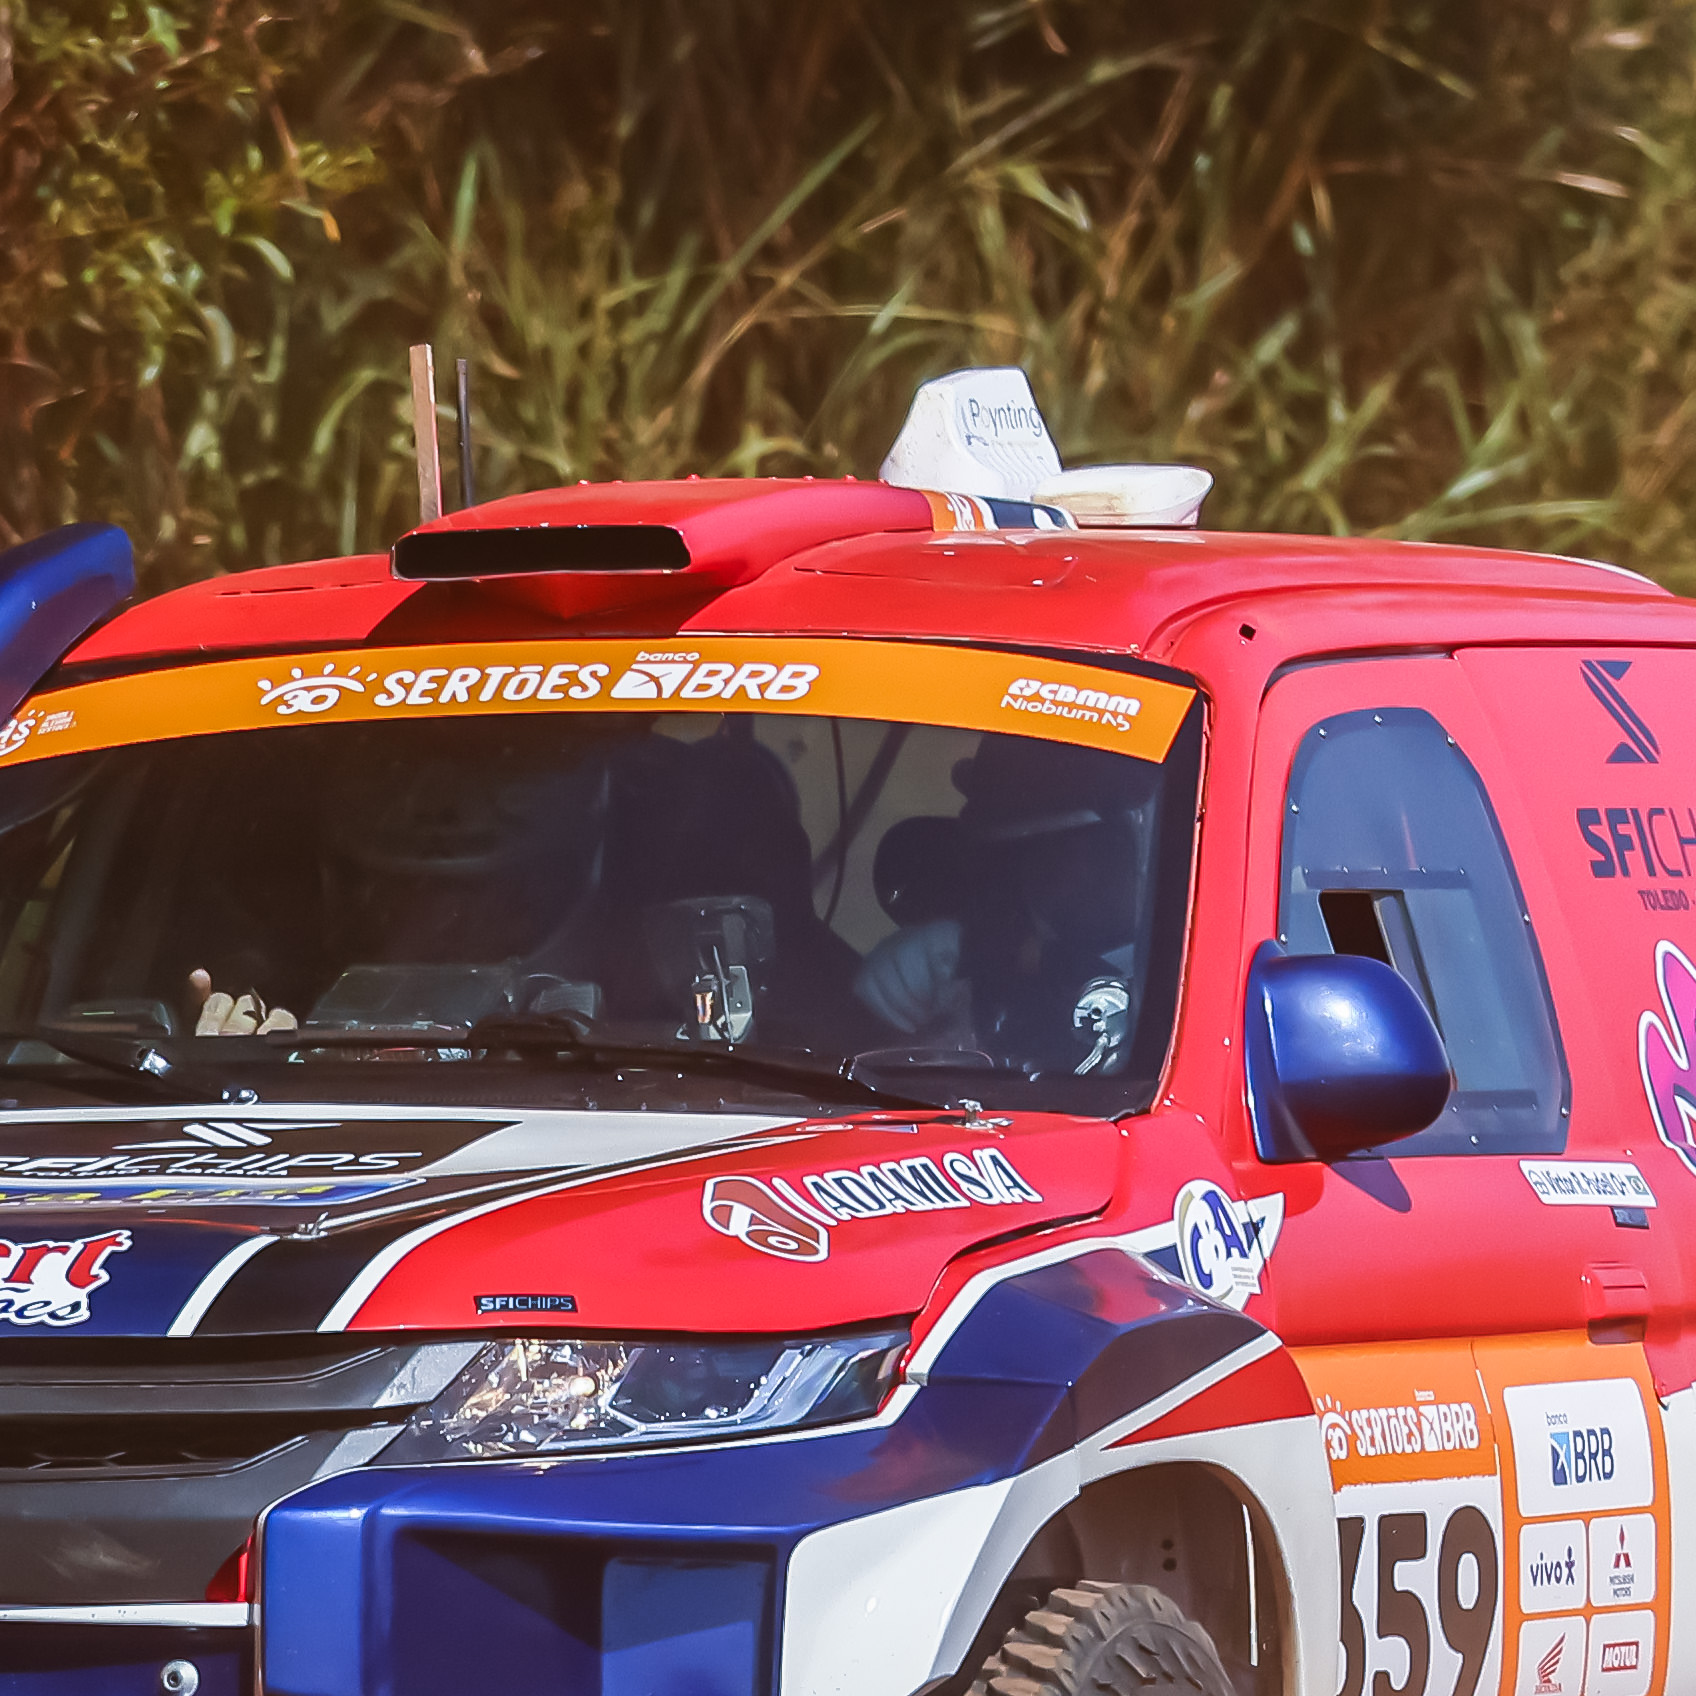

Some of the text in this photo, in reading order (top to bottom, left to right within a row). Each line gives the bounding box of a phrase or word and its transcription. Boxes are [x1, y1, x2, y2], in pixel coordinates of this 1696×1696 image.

[968, 398, 1043, 437] Poynting
[635, 650, 700, 662] banco
[373, 664, 610, 706] SERTÕES
[679, 662, 821, 701] BRB
[1039, 683, 1141, 716] CBMM
[999, 694, 1100, 723] Niobium
[806, 1149, 1041, 1217] ADAMI S/A
[480, 1296, 573, 1310] SFICHIPS
[1439, 1402, 1480, 1450] BRB
[1573, 1427, 1615, 1483] BRB
[1530, 1551, 1562, 1586] vivo
[1602, 1644, 1637, 1669] MOTUL
